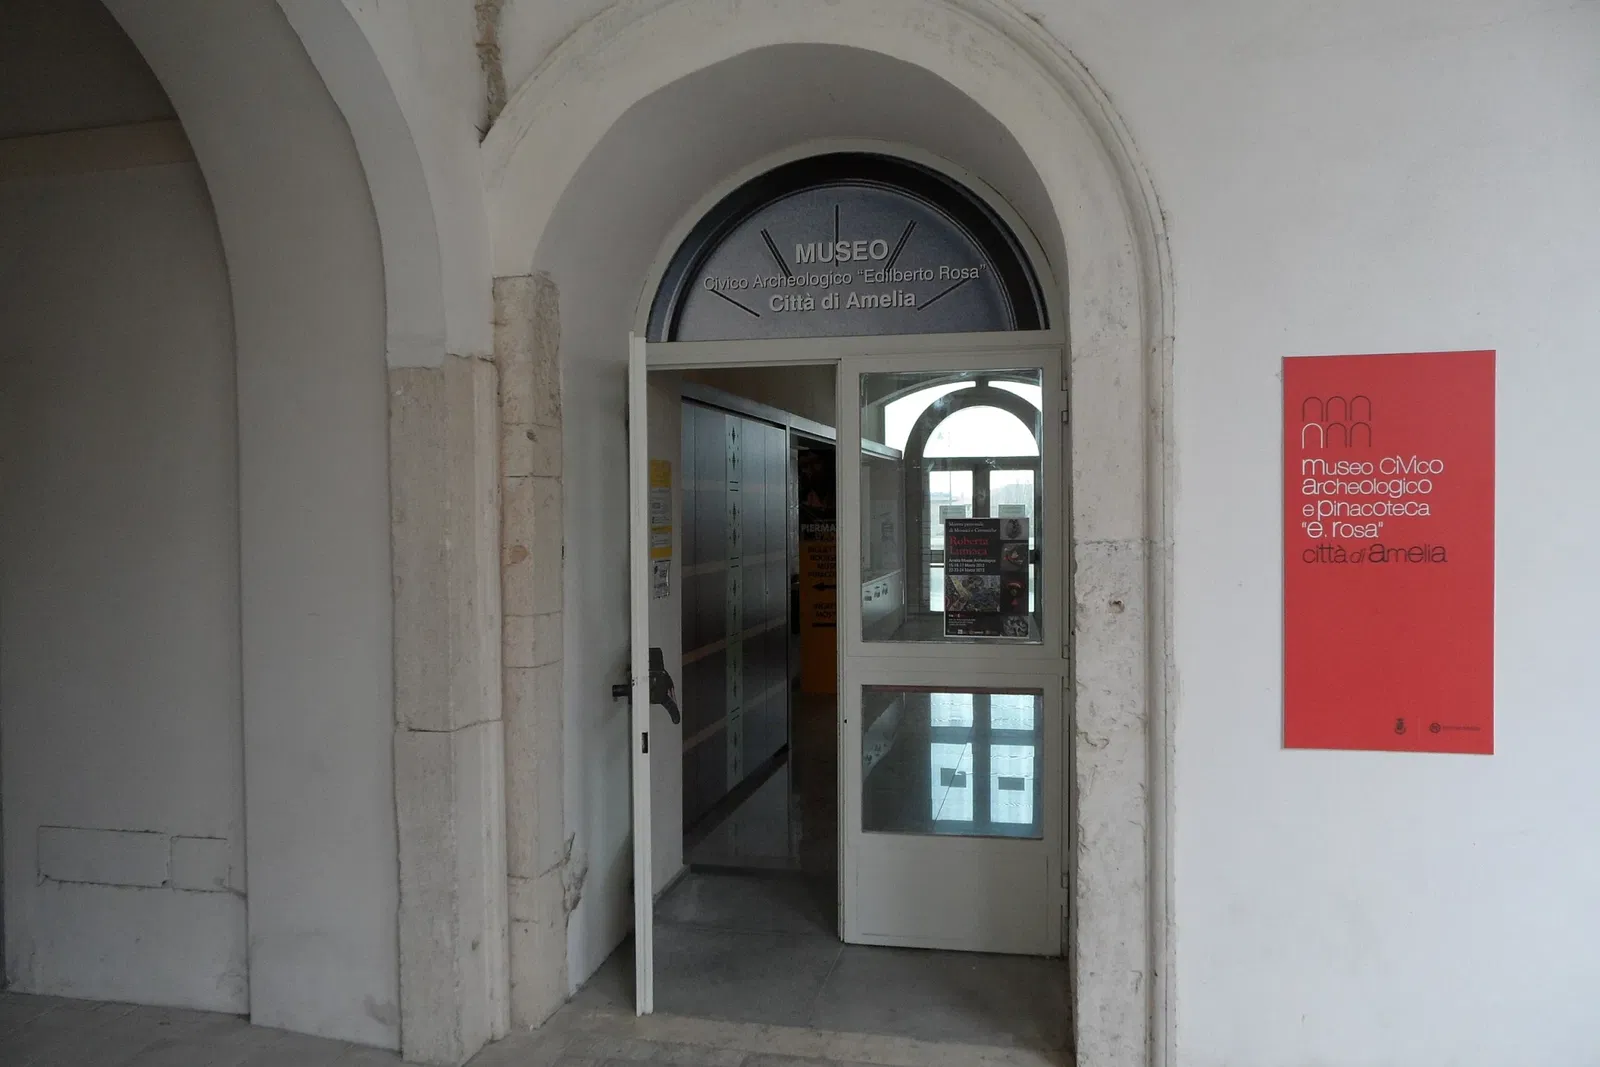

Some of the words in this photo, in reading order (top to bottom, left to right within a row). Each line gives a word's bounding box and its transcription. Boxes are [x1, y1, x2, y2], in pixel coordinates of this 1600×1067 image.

[795, 239, 889, 264] MUSEO
[703, 275, 749, 291] Civico
[752, 270, 852, 292] Archeologico
[768, 293, 815, 313] Città
[821, 291, 840, 310] di
[846, 290, 917, 309] Amelia
[1302, 458, 1374, 476] museo
[1302, 477, 1433, 499] archeologico
[1302, 503, 1315, 517] e
[1317, 500, 1431, 521] pinacoteca
[800, 523, 836, 533] PIERMA
[949, 535, 989, 546] Roberta
[1302, 544, 1348, 564] città
[1350, 547, 1366, 564] di
